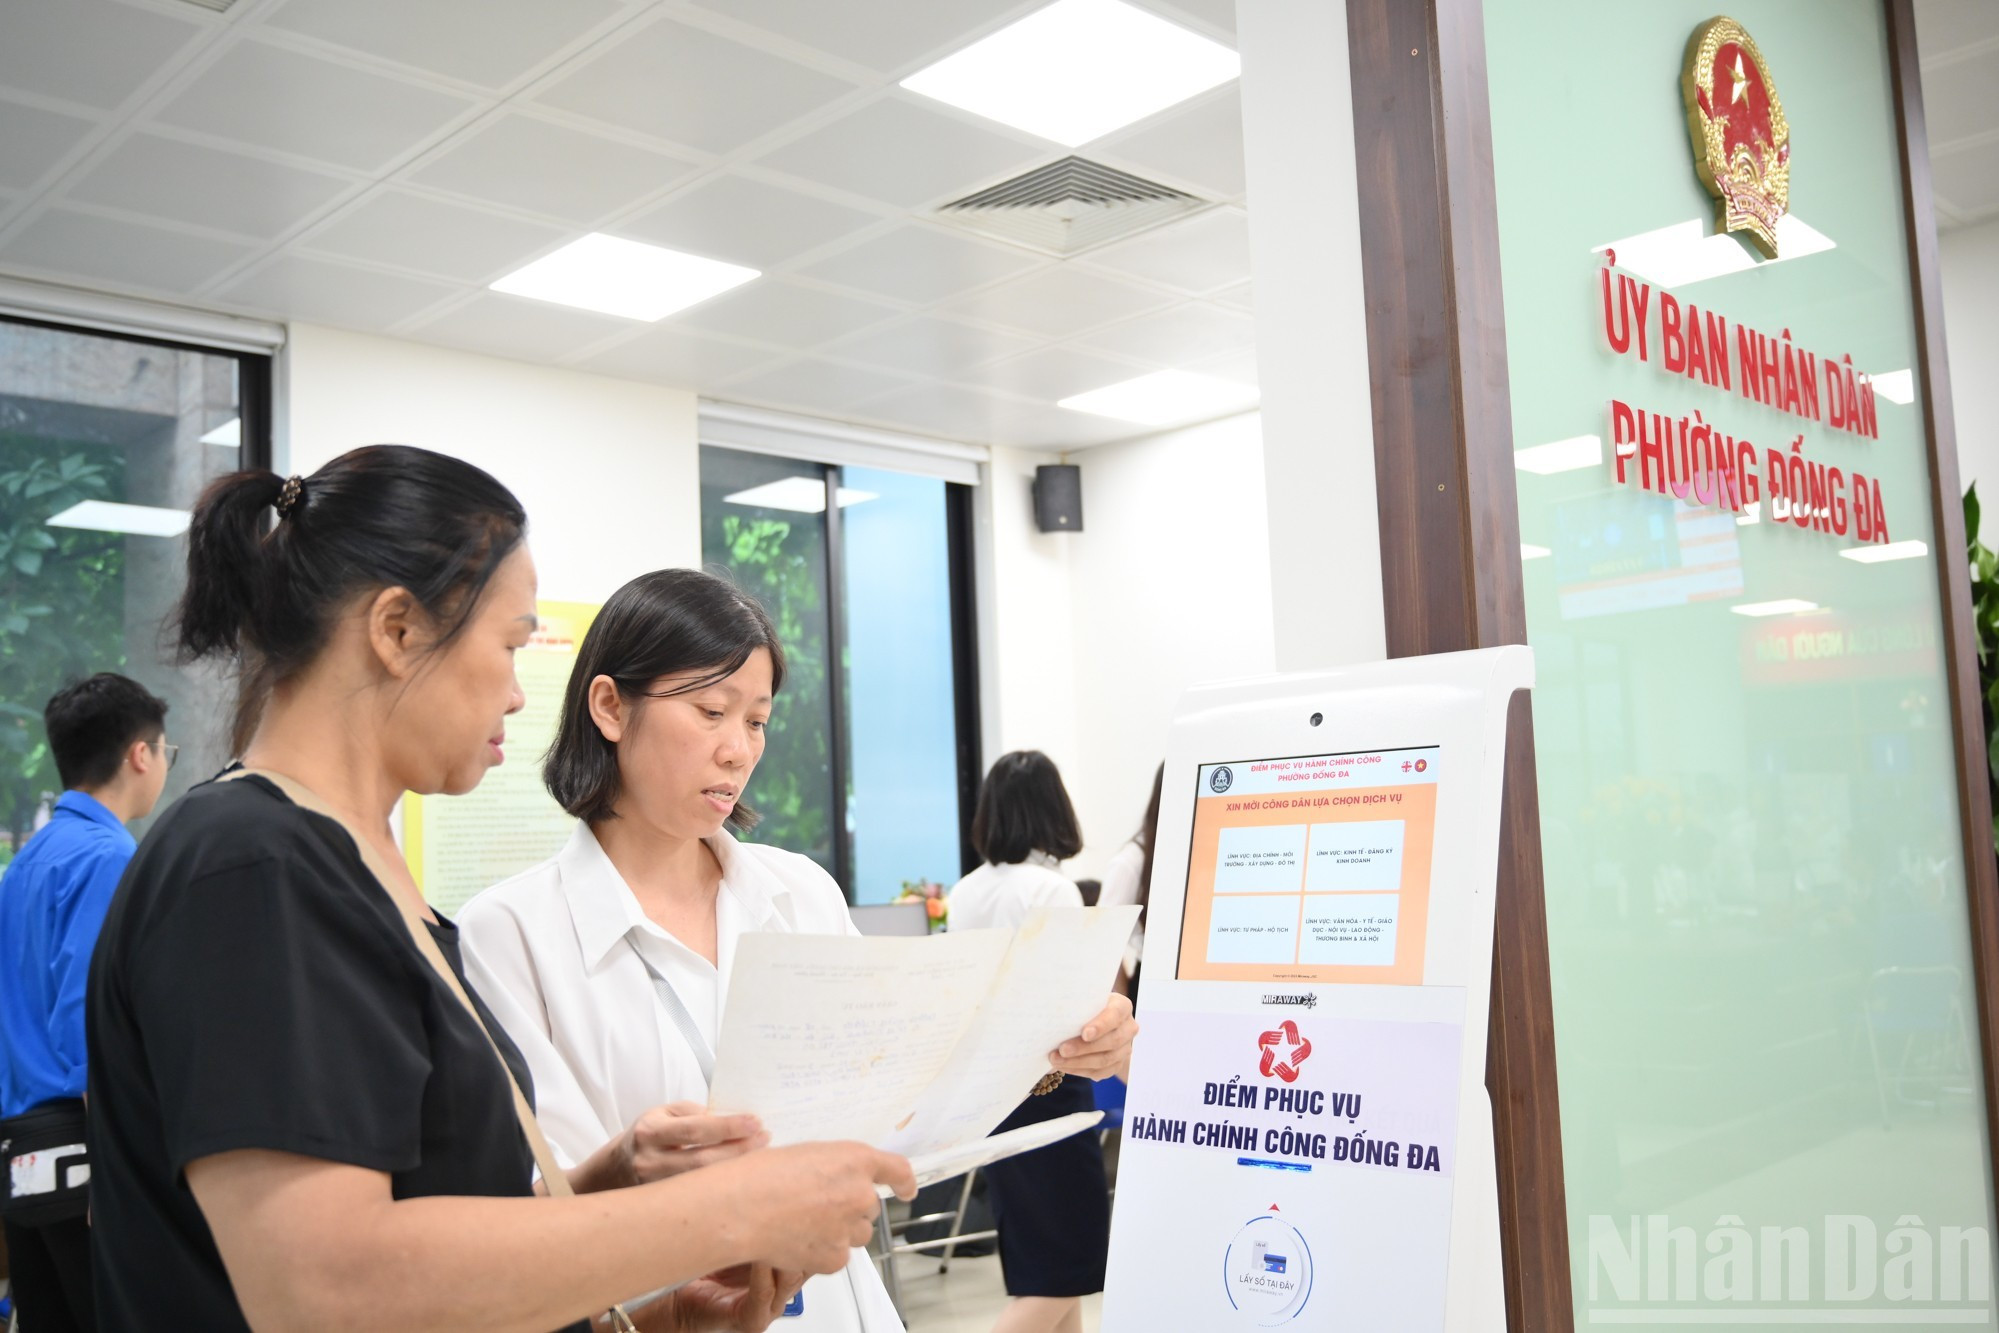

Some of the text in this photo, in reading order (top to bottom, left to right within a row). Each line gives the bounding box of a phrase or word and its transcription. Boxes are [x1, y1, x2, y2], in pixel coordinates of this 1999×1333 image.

[1601, 248, 1879, 440] ỦY BAN NHÂN DÂN
[1611, 399, 1890, 544] PHƯỜNG ĐỐNG ĐA
[1278, 770, 1349, 782] PHƯỜNG ĐỐNG ĐA
[1226, 793, 1402, 812] XIN MỜI CÔNG DÂN LỰA CHỌN DỊCH VỤ
[1262, 995, 1302, 1004] MIRAWAY
[1203, 1075, 1257, 1109] ĐIỂM
[1265, 1086, 1324, 1119] PHỤC
[1332, 1092, 1361, 1124] VỤ
[1131, 1113, 1441, 1172] HÀNH CHÍNH CÔNG ĐỐNG ĐA
[1239, 1273, 1294, 1290] LẤY SỐ TẠI ĐÂY
